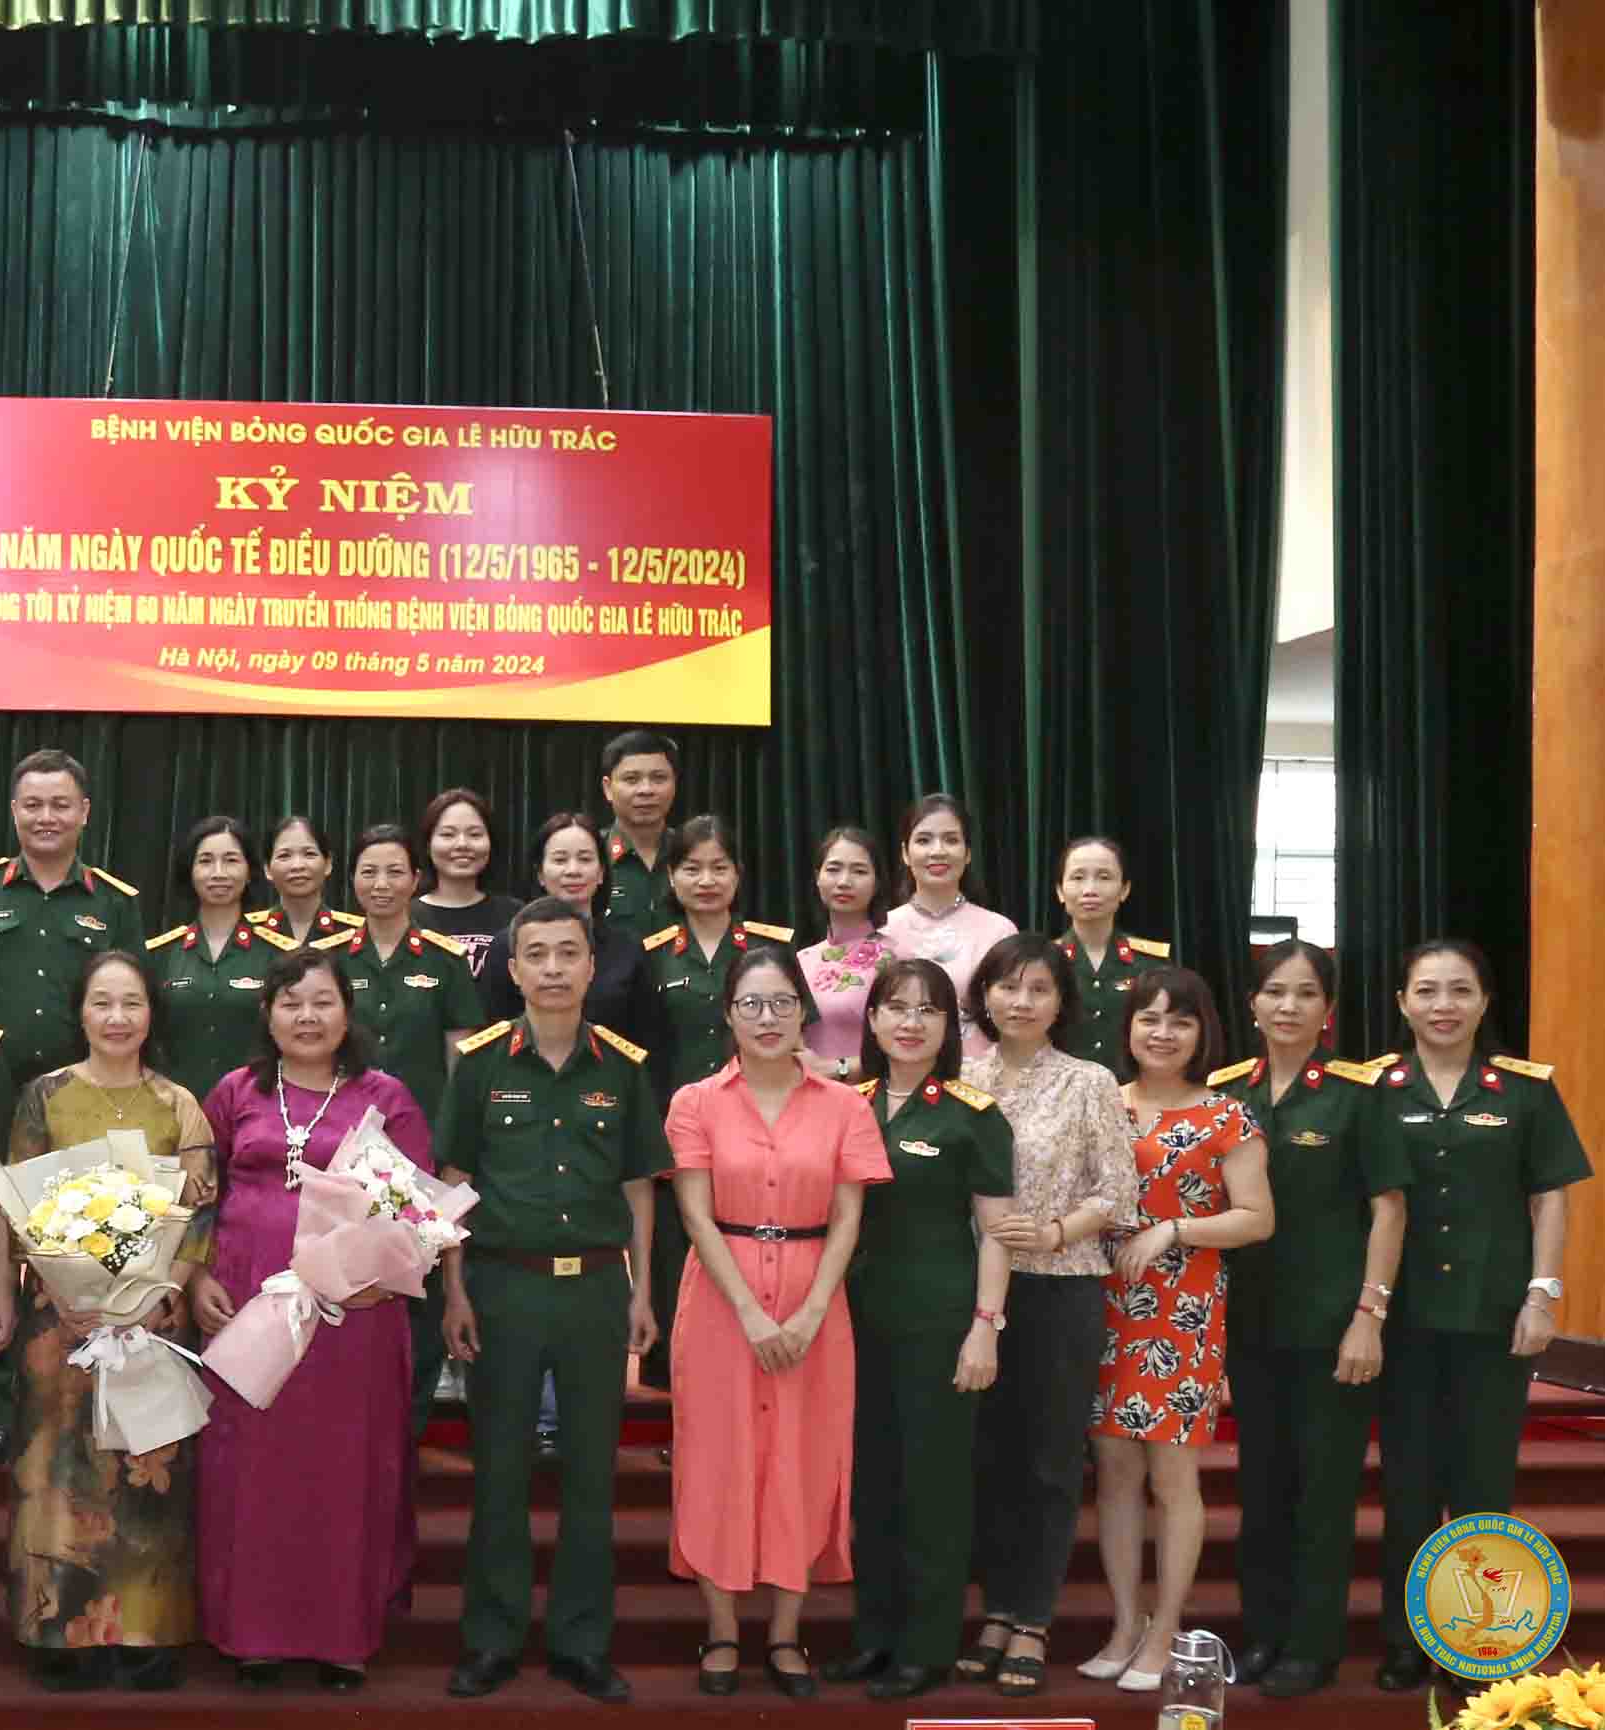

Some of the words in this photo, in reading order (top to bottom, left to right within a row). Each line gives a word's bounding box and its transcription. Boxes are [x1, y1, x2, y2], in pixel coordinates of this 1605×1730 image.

[91, 414, 157, 445] BỆNH
[164, 415, 223, 447] VIỆN
[231, 416, 307, 444] BỎNG
[315, 417, 395, 446] QUỐC
[402, 425, 449, 447] GIA
[458, 421, 482, 448] LÊ
[490, 424, 542, 448] HỮU
[549, 425, 617, 450] TRÁC
[215, 465, 299, 511] KỶ
[319, 472, 475, 522] NIỆM
[70, 527, 143, 572] NGÀY
[150, 523, 223, 577] QUỐC
[230, 526, 264, 575] TẾ
[269, 527, 331, 576] ĐIỀU
[339, 533, 430, 578] DƯỠNG
[440, 543, 580, 583] (12/5/1965
[607, 546, 746, 590] 12/5/2024)
[25, 588, 53, 622] TỚI
[57, 584, 81, 624] KỶ
[85, 588, 132, 631] NIỆM
[136, 595, 158, 625] 60
[163, 591, 205, 625] NĂM
[209, 591, 257, 625] NGÀY
[334, 591, 392, 630] THỐNG
[396, 596, 444, 636] BỆNH
[448, 597, 490, 637] VIỆN
[494, 593, 542, 633] BỎNG
[547, 595, 594, 637] QUỐC
[599, 605, 628, 635] GIA
[633, 601, 653, 635] LÊ
[658, 602, 693, 636] HỮU
[698, 603, 743, 638] TRÁC
[159, 647, 189, 667] Hà
[196, 648, 241, 672] Nội,
[249, 650, 305, 673] ngày
[312, 652, 339, 670] 09
[345, 651, 410, 676] tháng
[416, 653, 429, 673] 5
[436, 654, 484, 673] năm
[491, 655, 545, 674] 2024
